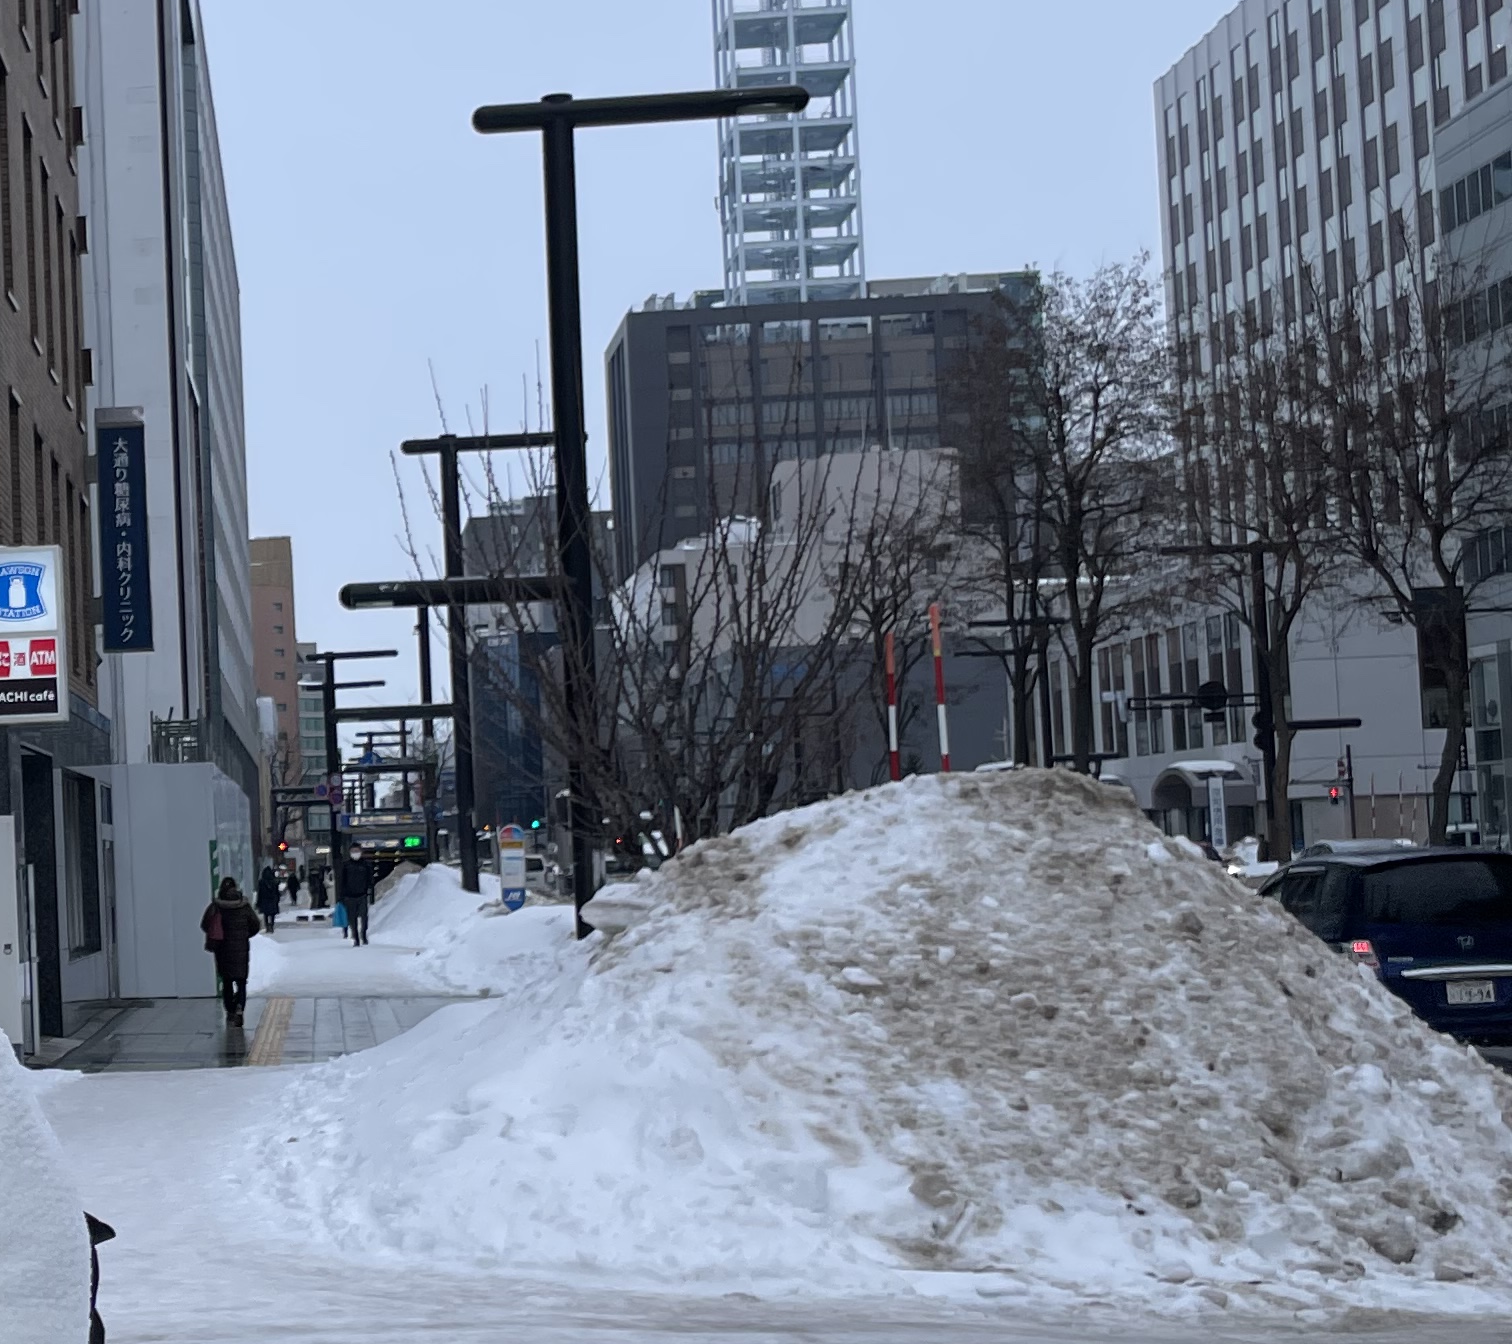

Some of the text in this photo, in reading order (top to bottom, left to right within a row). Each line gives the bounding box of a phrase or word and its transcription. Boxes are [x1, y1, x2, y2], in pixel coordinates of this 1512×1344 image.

[112, 437, 134, 643] 大通り糖尿病・内科クリニック
[14, 652, 26, 666] 酒
[30, 650, 56, 666] ATM
[29, 689, 56, 702] café
